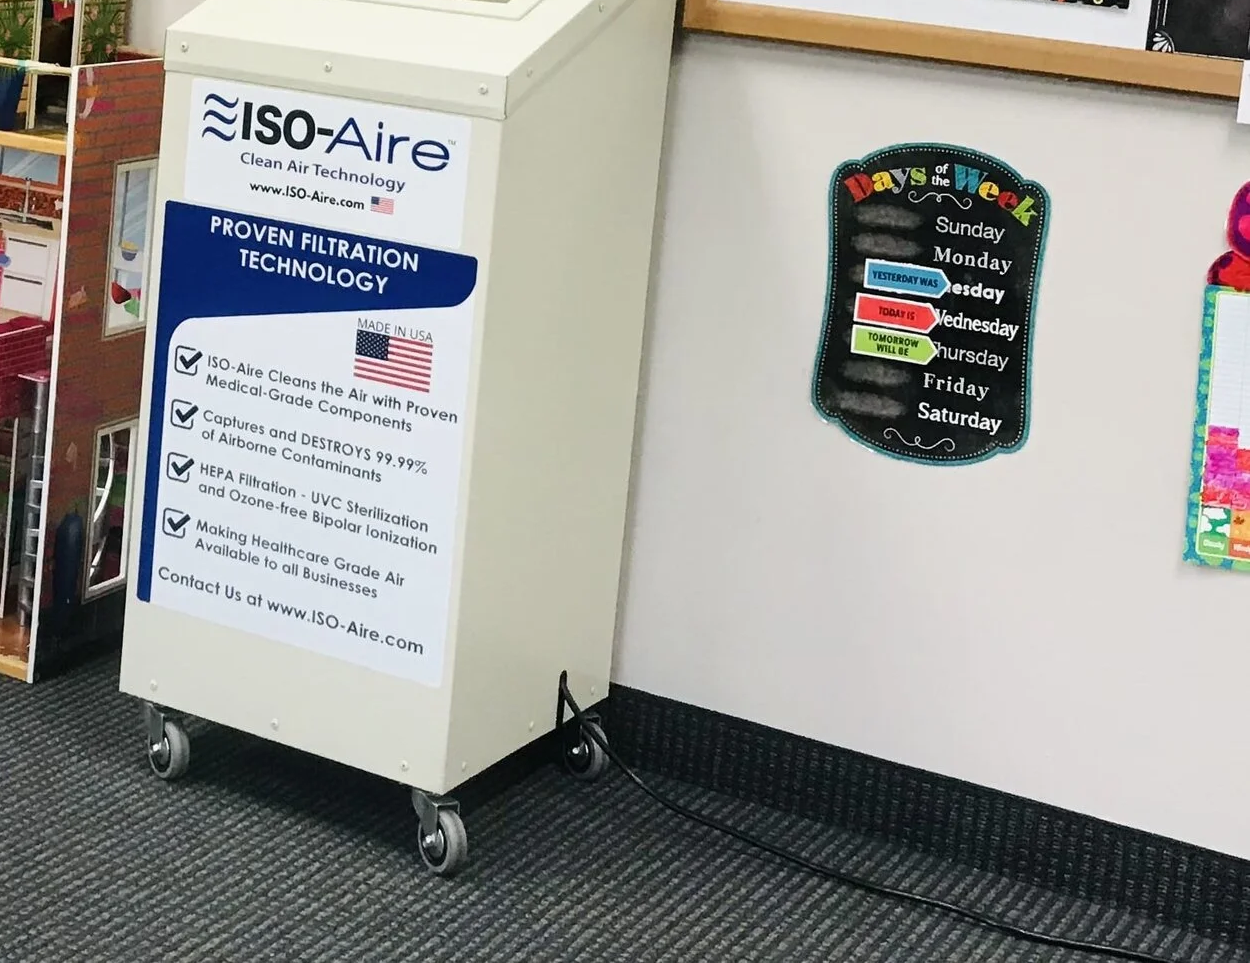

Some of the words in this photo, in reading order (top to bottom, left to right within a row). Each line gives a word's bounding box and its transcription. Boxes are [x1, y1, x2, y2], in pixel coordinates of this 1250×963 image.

[241, 101, 451, 172] ISO-Aire
[240, 152, 282, 171] Clean
[287, 161, 310, 175] Air
[312, 164, 406, 193] Technology
[844, 164, 927, 203] Days
[932, 175, 950, 187] the
[935, 163, 949, 175] of
[249, 181, 365, 211] www.ISO-Aire.com
[954, 163, 1038, 227] Week
[210, 215, 294, 249] PROVEN
[301, 232, 419, 272] FILTRATION
[935, 216, 1005, 242] Sunday
[240, 248, 389, 294] TECHNOLOGY
[872, 269, 918, 286] YESTERDAY
[920, 275, 938, 288] WAS
[933, 246, 1012, 275] Monday
[948, 281, 1005, 306] esday
[357, 317, 391, 335] MADE
[393, 326, 407, 337] IN
[410, 329, 433, 343] USA
[878, 306, 905, 319] TODAY
[906, 312, 915, 321] IS
[868, 331, 919, 348] TOMORROW
[876, 343, 896, 355] WILL
[897, 346, 909, 356] BE
[933, 340, 1009, 371] hursday
[206, 374, 314, 410] Medical-Grade
[318, 400, 413, 433] Components
[207, 355, 264, 379] ISO-Aire
[268, 369, 317, 391] Cleans
[321, 380, 344, 398] the
[348, 389, 367, 403] Air
[372, 394, 401, 411] with
[407, 401, 458, 424] Proven
[923, 372, 990, 401] Friday
[918, 402, 1002, 435] Saturday
[201, 428, 217, 441] of
[218, 433, 278, 458] Airborne
[282, 447, 382, 483] Contaminants
[203, 410, 265, 436] Captures
[269, 426, 297, 443] and
[301, 433, 371, 462] DESTROYS
[376, 451, 428, 475] 99.99%
[200, 463, 235, 483] HEPA
[239, 472, 297, 499] Filtration
[311, 490, 342, 511] UVC
[346, 500, 429, 533] Sterilization
[198, 481, 225, 499] and
[229, 488, 308, 520] Ozone-free
[312, 509, 362, 536] Bipolar
[366, 525, 437, 555] Ionization
[194, 538, 261, 567] Available
[264, 556, 278, 571] to
[282, 561, 299, 577] all
[303, 566, 378, 599] Businesses
[196, 518, 248, 546] Making
[251, 533, 330, 567] Healthcare
[334, 556, 381, 581] Grade
[384, 570, 405, 588] Air
[158, 566, 221, 596] Contact
[224, 585, 242, 603] Us
[246, 592, 264, 608] at
[266, 599, 424, 655] www.ISO-Aire.com
